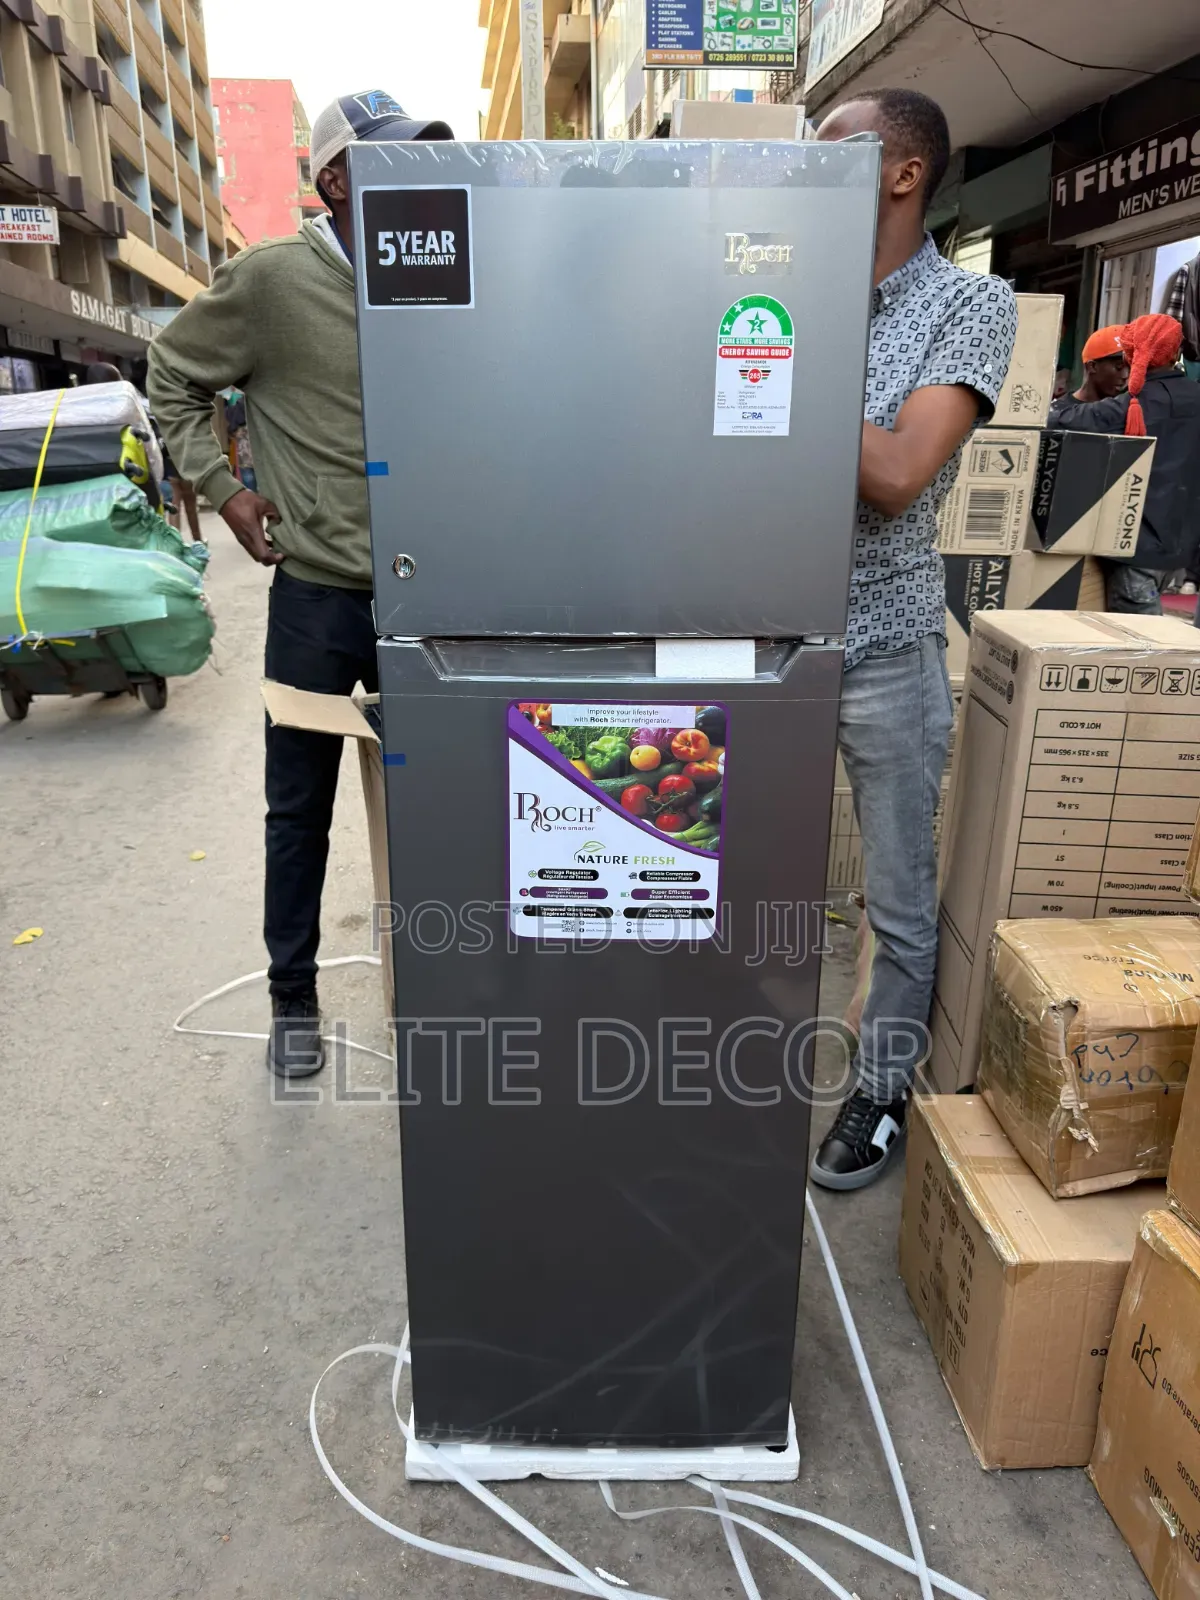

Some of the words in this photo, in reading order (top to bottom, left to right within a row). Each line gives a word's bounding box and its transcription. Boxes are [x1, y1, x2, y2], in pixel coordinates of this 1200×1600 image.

[1118, 184, 1171, 219] MEN'S
[11, 207, 51, 223] HOTEL
[401, 254, 457, 266] WARRANTY
[70, 289, 128, 334] SAMAGAT
[753, 319, 761, 330] 2
[721, 348, 745, 356] ENERGY
[746, 348, 769, 356] SAVING
[770, 349, 790, 357] GUIDE
[978, 450, 987, 473] KEBS
[1036, 438, 1060, 517] AILYONS
[1119, 473, 1143, 550] AILYONS
[1010, 528, 1019, 550] MADE
[1015, 489, 1024, 515] KENYA
[972, 562, 984, 585] HOT
[587, 708, 615, 717] Improve
[616, 709, 631, 718] your
[632, 709, 659, 717] lifestyle
[631, 717, 672, 725] refrigerator.
[1059, 721, 1079, 729] COLD
[1086, 721, 1102, 730] HOT
[1058, 749, 1071, 757] 965
[1178, 753, 1195, 761] SIZE
[1061, 775, 1071, 783] kg
[1057, 802, 1067, 810] kg
[1154, 832, 1174, 841] Class
[1175, 833, 1193, 841] tion
[577, 855, 629, 865] NATURE
[633, 855, 676, 865] FRESH
[1160, 858, 1180, 867] Class
[1103, 881, 1157, 892] Input(Cooling)
[1158, 884, 1181, 893] Power
[1109, 907, 1157, 916] Input(Heating)
[1143, 1465, 1163, 1499] MUG
